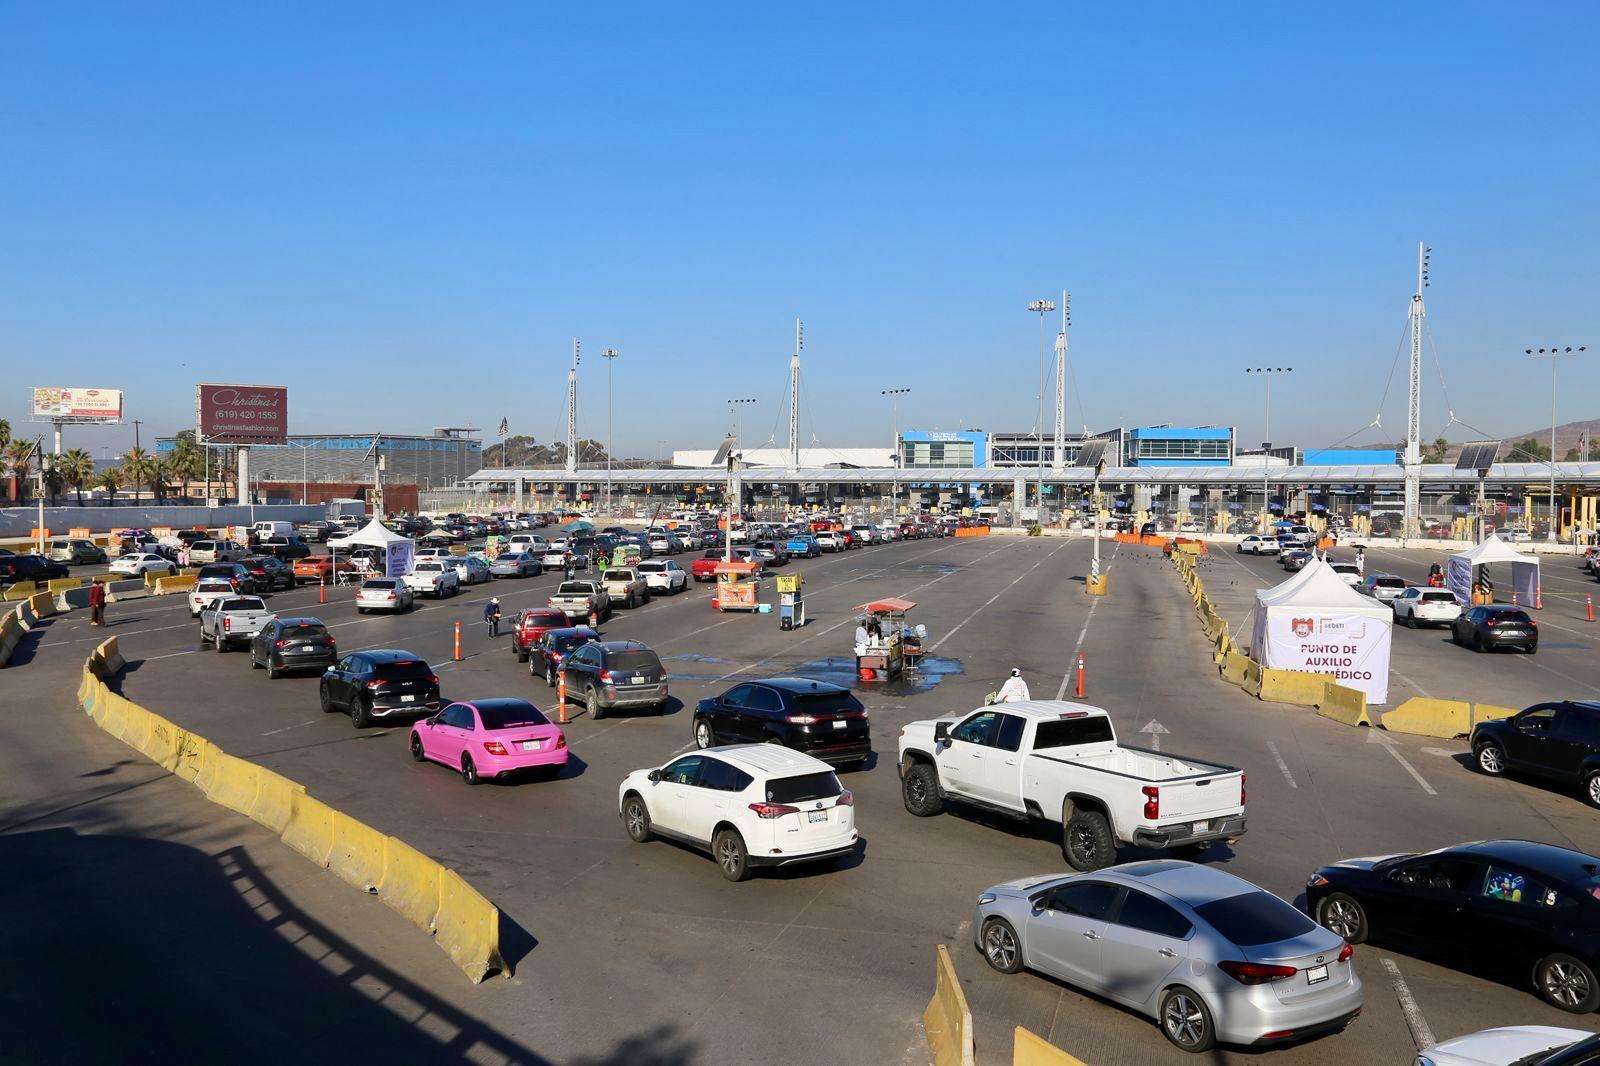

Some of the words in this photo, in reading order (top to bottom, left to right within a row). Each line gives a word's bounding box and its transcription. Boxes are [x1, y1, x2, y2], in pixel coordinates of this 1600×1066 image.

[212, 389, 280, 407] Christina's
[215, 410, 238, 420] (619)
[239, 410, 255, 420] 420
[258, 410, 277, 420] 1553
[212, 423, 279, 432] christinasfashion.com
[1301, 644, 1339, 654] PUNTO
[1342, 645, 1357, 654] DE
[1305, 657, 1352, 667] AUXILIO
[1325, 668, 1372, 680] MÉDICO
